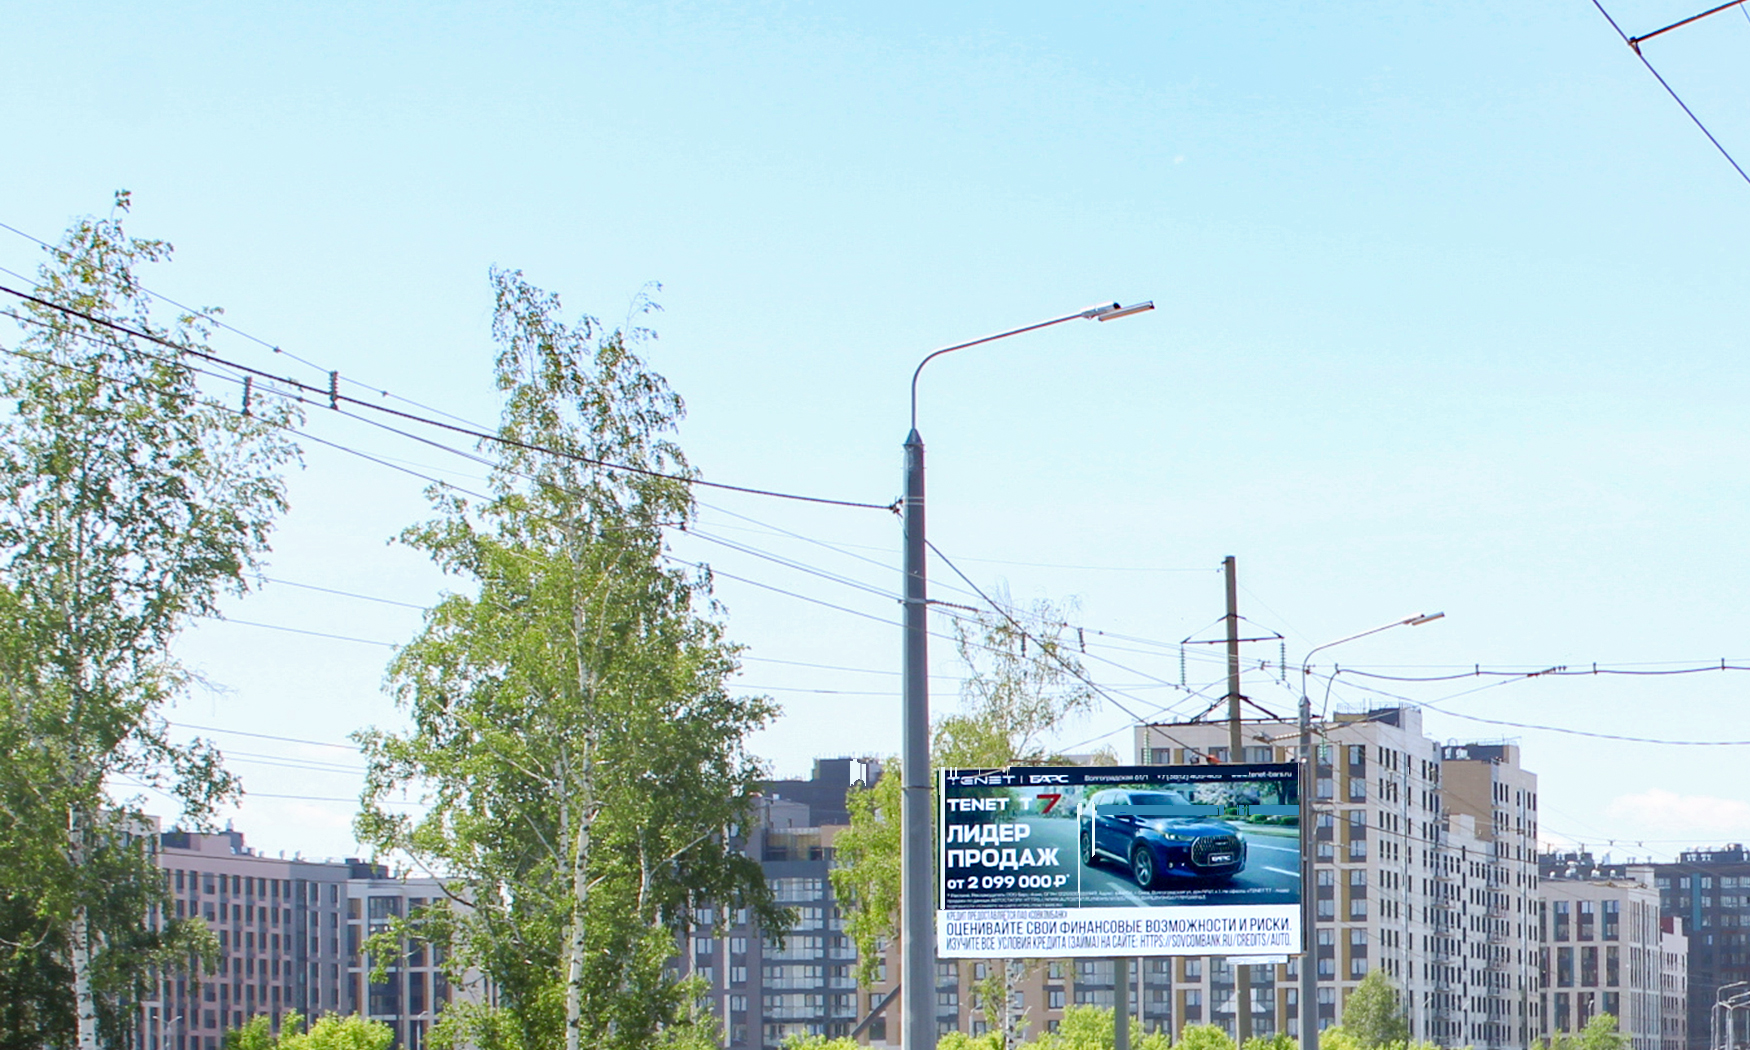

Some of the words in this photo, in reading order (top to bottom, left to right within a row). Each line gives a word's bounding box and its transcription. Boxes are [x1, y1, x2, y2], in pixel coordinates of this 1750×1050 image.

[947, 797, 1010, 811] TENET
[946, 823, 1031, 846] ЛИДЕР
[947, 847, 1060, 871] ПРОДАЖ
[947, 879, 965, 889] от
[967, 876, 979, 889] 2
[982, 875, 1016, 889] 099
[946, 920, 1023, 936] ОЦЕНИВАЙТЕ
[1026, 920, 1056, 935] СВОИ
[1059, 919, 1142, 935] ФИНАНСОВЫЕ
[1145, 918, 1237, 933] ВОЗМОЖНОСТИ
[1239, 918, 1246, 932] И
[1250, 917, 1292, 932] РИСКИ.
[946, 936, 980, 951] ИЗУЧИТЕ
[981, 936, 995, 950] ВСЕ
[998, 936, 1032, 950] УСЛОВИЯ
[1033, 935, 1066, 950] КРЕДИТА
[1101, 934, 1111, 948] НА
